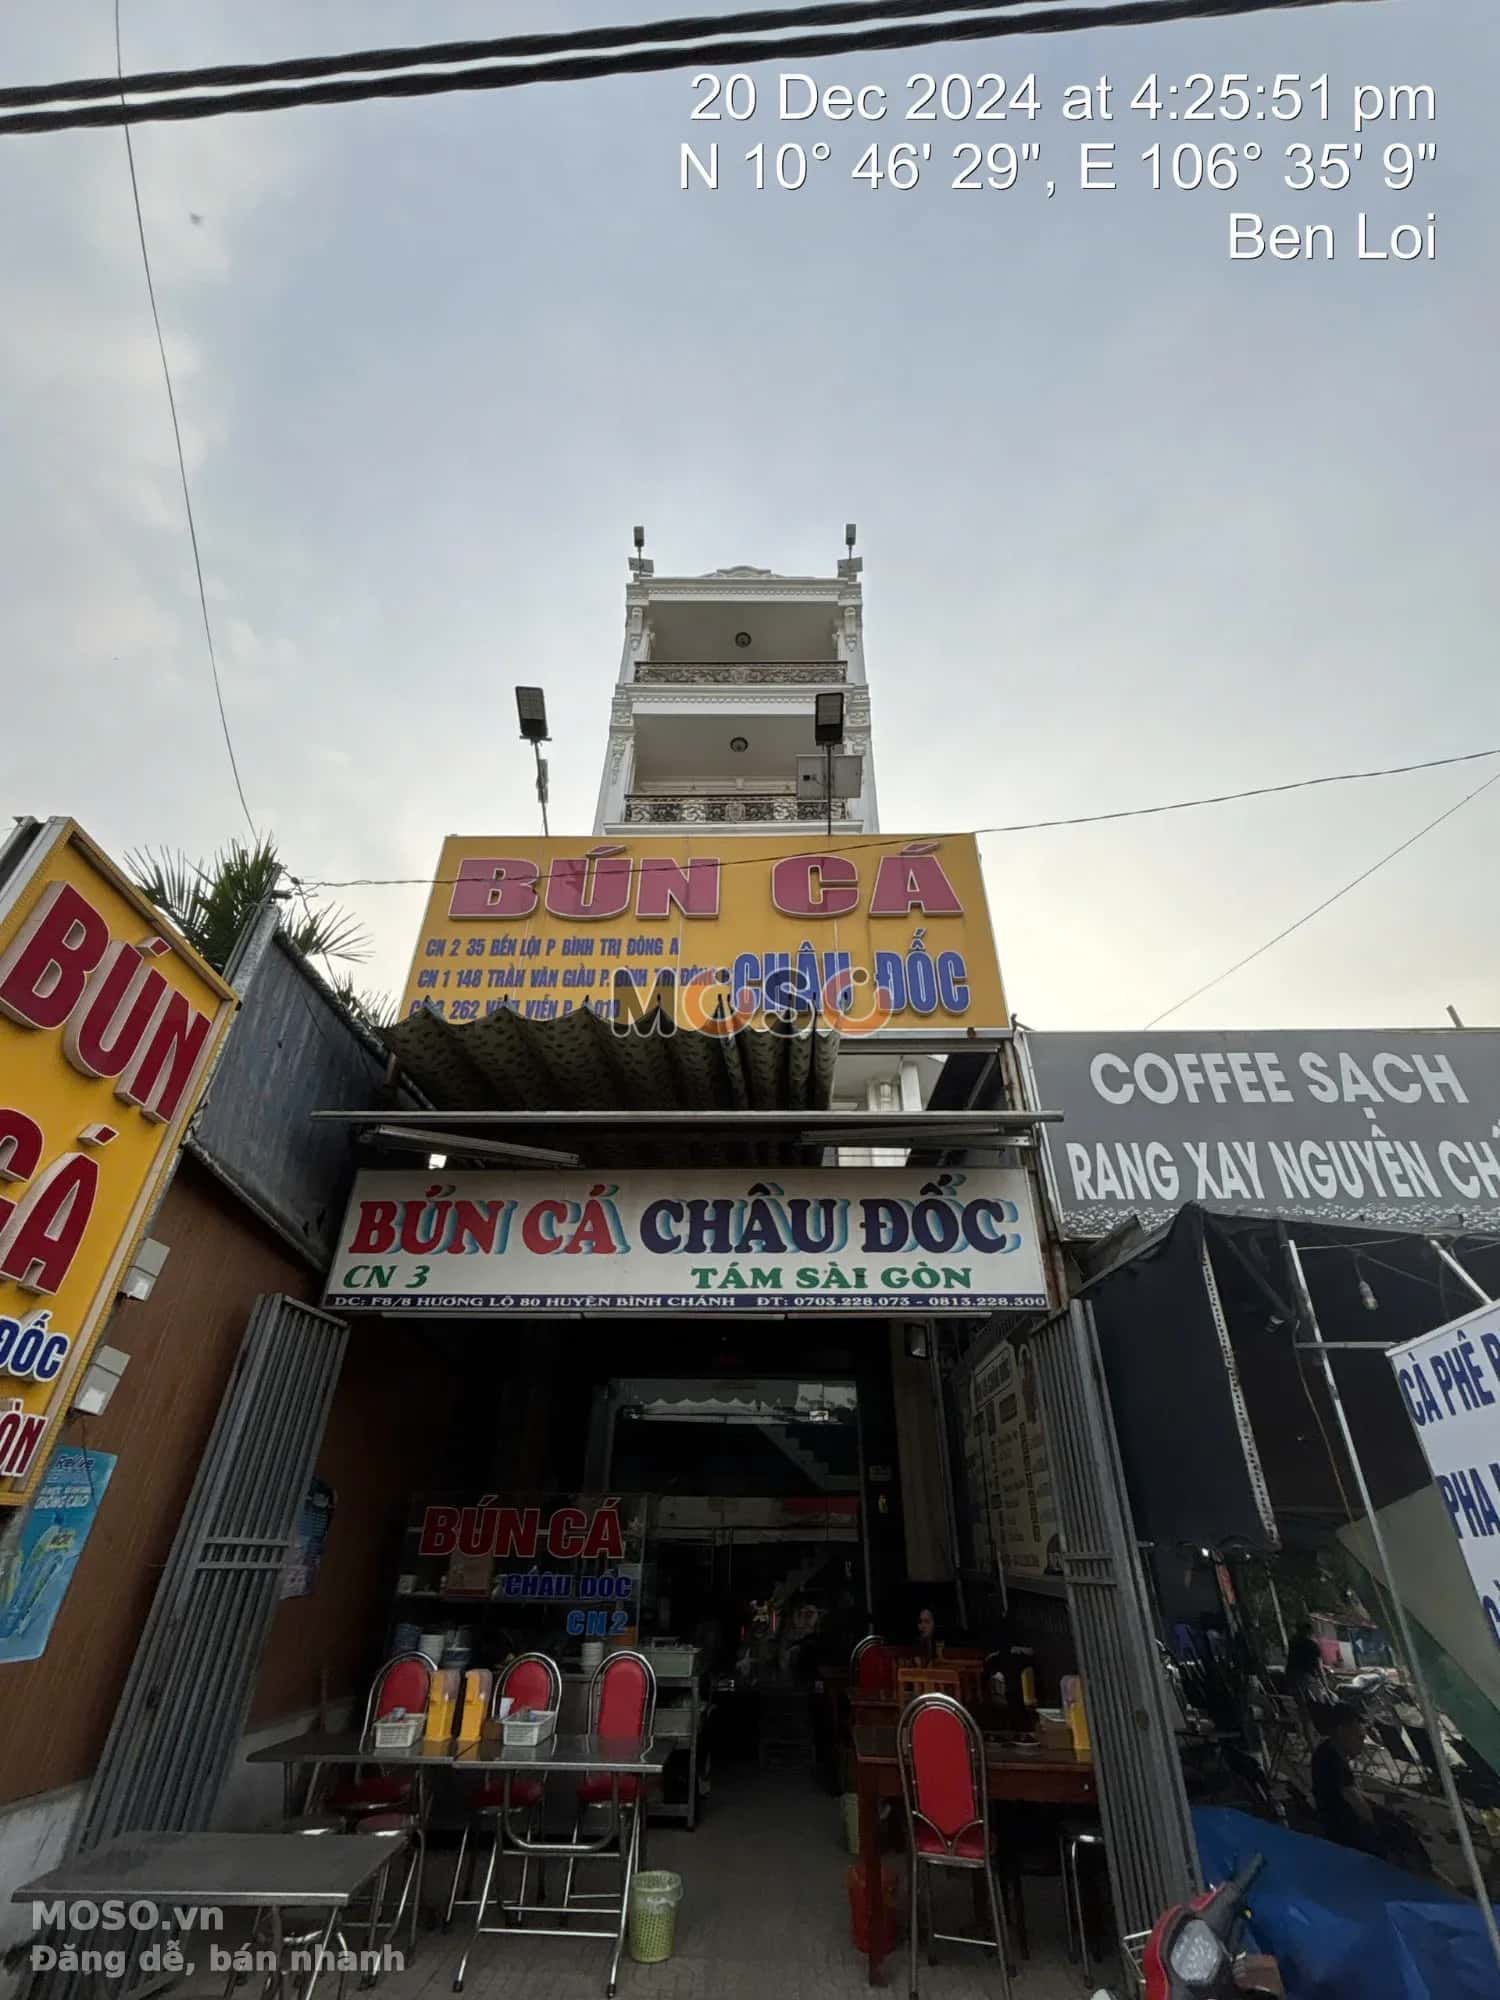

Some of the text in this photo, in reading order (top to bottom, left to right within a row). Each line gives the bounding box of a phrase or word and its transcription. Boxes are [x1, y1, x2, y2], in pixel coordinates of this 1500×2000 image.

[448, 842, 965, 920] BÚN CÁ
[425, 938, 447, 957] CN
[449, 938, 462, 956] 2
[466, 938, 486, 956] 35
[669, 938, 680, 955] A
[730, 928, 971, 1018] CHÂU ĐỐC
[0, 879, 214, 1125] BÚN
[417, 969, 439, 988] CN
[442, 969, 451, 988] 1
[456, 969, 483, 988] 148
[1090, 1052, 1294, 1105] COFFEE
[1066, 1142, 1180, 1202] RANG
[1184, 1142, 1265, 1199] XAY
[1438, 1119, 1500, 1199] CH
[349, 1174, 1022, 1255] BÚN CÁ CHÂU ĐỐC
[343, 1265, 431, 1289] CN 3
[520, 1297, 541, 1306] 80
[691, 1261, 972, 1289] TÁM SÀI GÒN
[1399, 1351, 1444, 1427] CÀ
[1429, 1329, 1497, 1417] PHÊ
[418, 1494, 626, 1559] BÚN CÁ
[566, 1609, 629, 1637] CN 2
